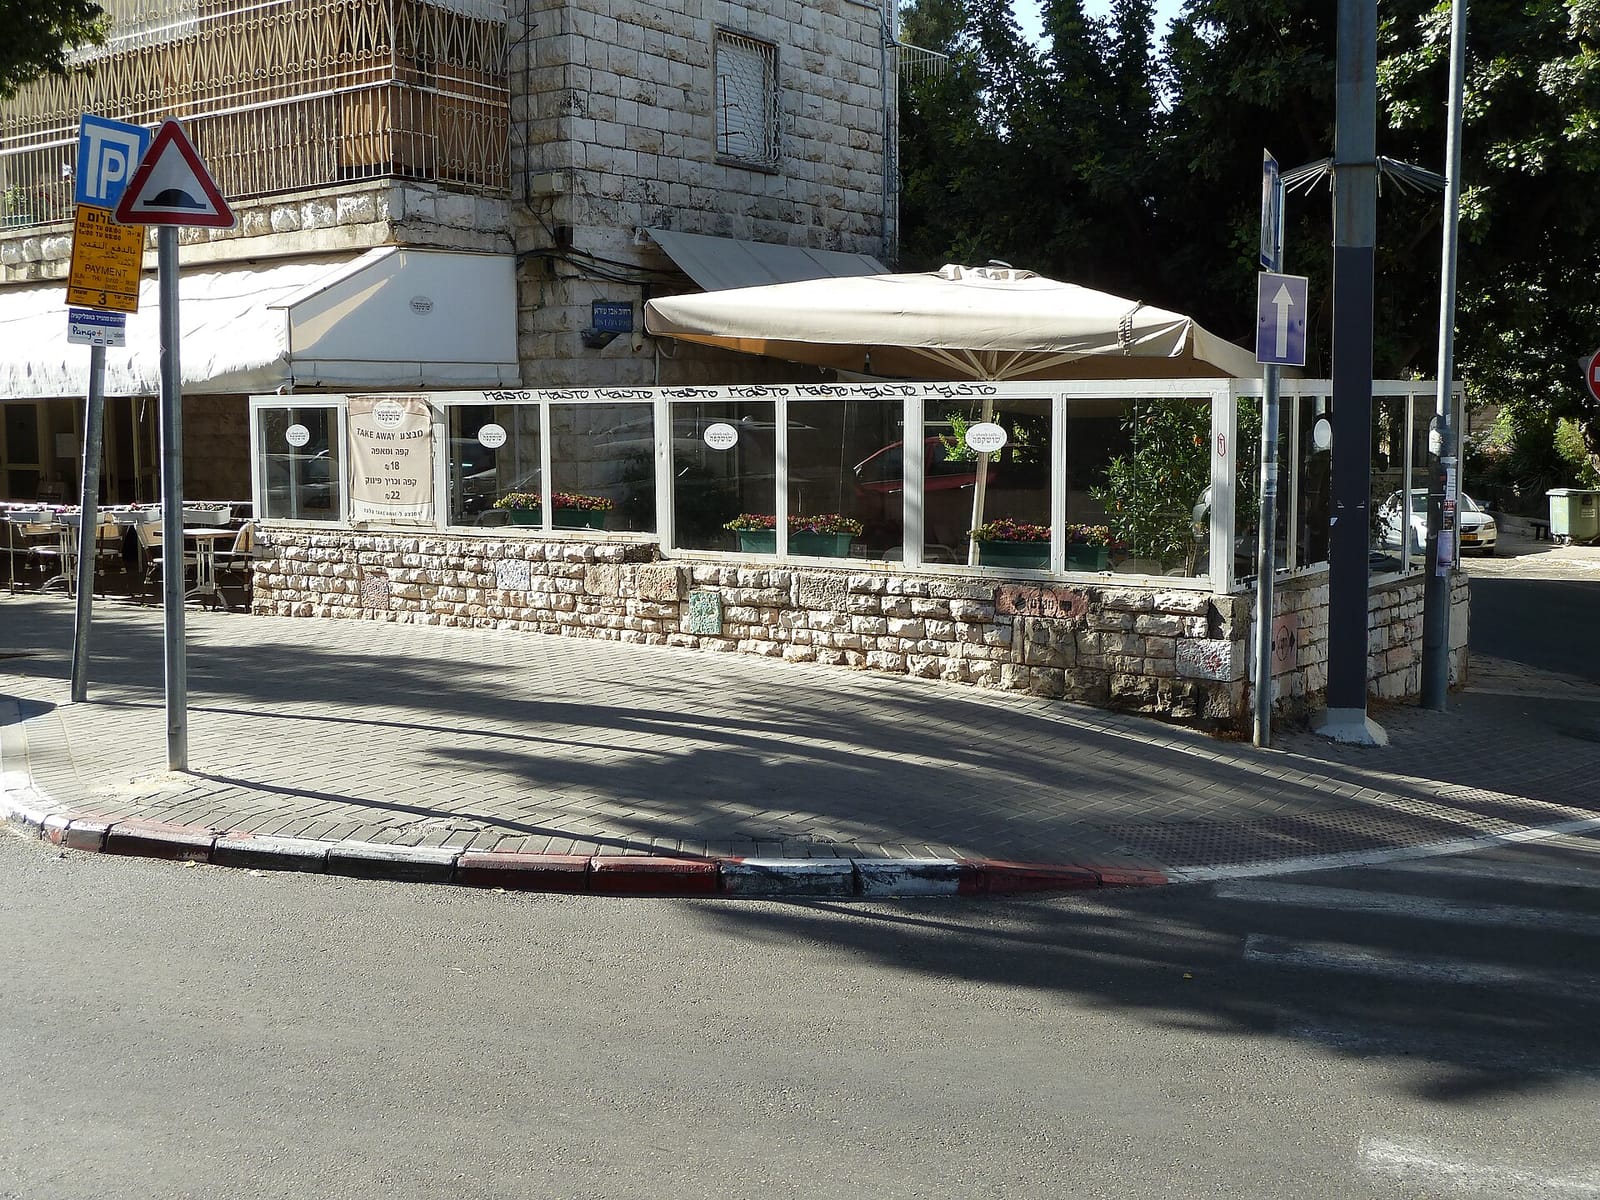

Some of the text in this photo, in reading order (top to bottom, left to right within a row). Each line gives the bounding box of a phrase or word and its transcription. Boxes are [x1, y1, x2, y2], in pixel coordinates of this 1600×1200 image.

[84, 263, 129, 278] PAYMENT
[98, 293, 107, 306] 3
[356, 427, 424, 441] מבצע TAKE AWAY
[371, 447, 410, 457] קפה ומאפה
[384, 477, 401, 486] וכריך
[402, 479, 417, 488] קפה
